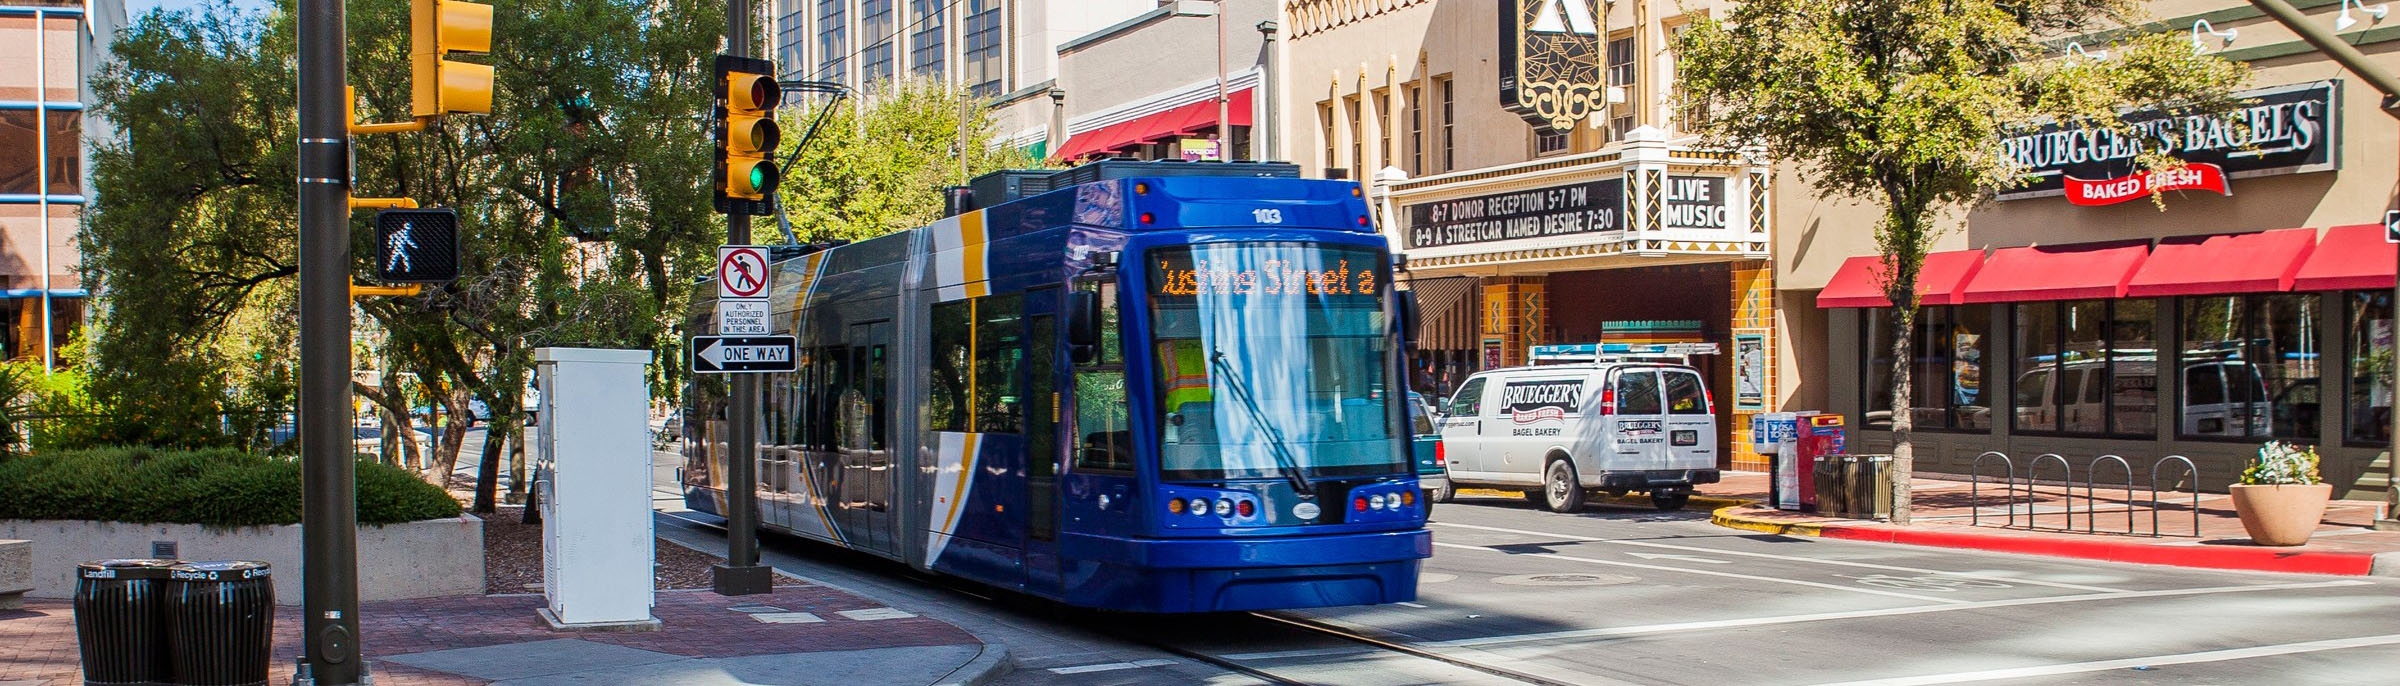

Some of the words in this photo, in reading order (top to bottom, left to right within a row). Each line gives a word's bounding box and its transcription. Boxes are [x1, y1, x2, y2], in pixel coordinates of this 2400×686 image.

[2184, 101, 2316, 152] BAGELS
[1667, 178, 1710, 201] LIVE
[2083, 178, 2140, 199] BAKED
[2145, 169, 2203, 190] FRESH
[1251, 208, 1283, 224] 103
[1452, 199, 1484, 221] DONOR
[1488, 190, 1544, 217] RECEPTION
[1570, 186, 1587, 207] PM
[1667, 203, 1725, 228] MUSIC
[1435, 225, 1443, 245] A
[1446, 219, 1503, 244] STREETCAR
[1506, 215, 1540, 239] NAMED
[1543, 211, 1583, 235] DESIRE
[1586, 207, 1614, 231] 7:30
[1161, 260, 1256, 295] ushing
[1264, 259, 1352, 295] Street
[1358, 269, 1376, 295] a
[724, 347, 750, 361] ONE
[756, 347, 785, 361] WAY
[1502, 384, 1581, 409] BRUEGGER'S
[1512, 428, 1533, 436] BAGEL
[1535, 428, 1561, 436] BAKERY
[84, 569, 115, 578] Landfill
[177, 570, 206, 580] Recycle
